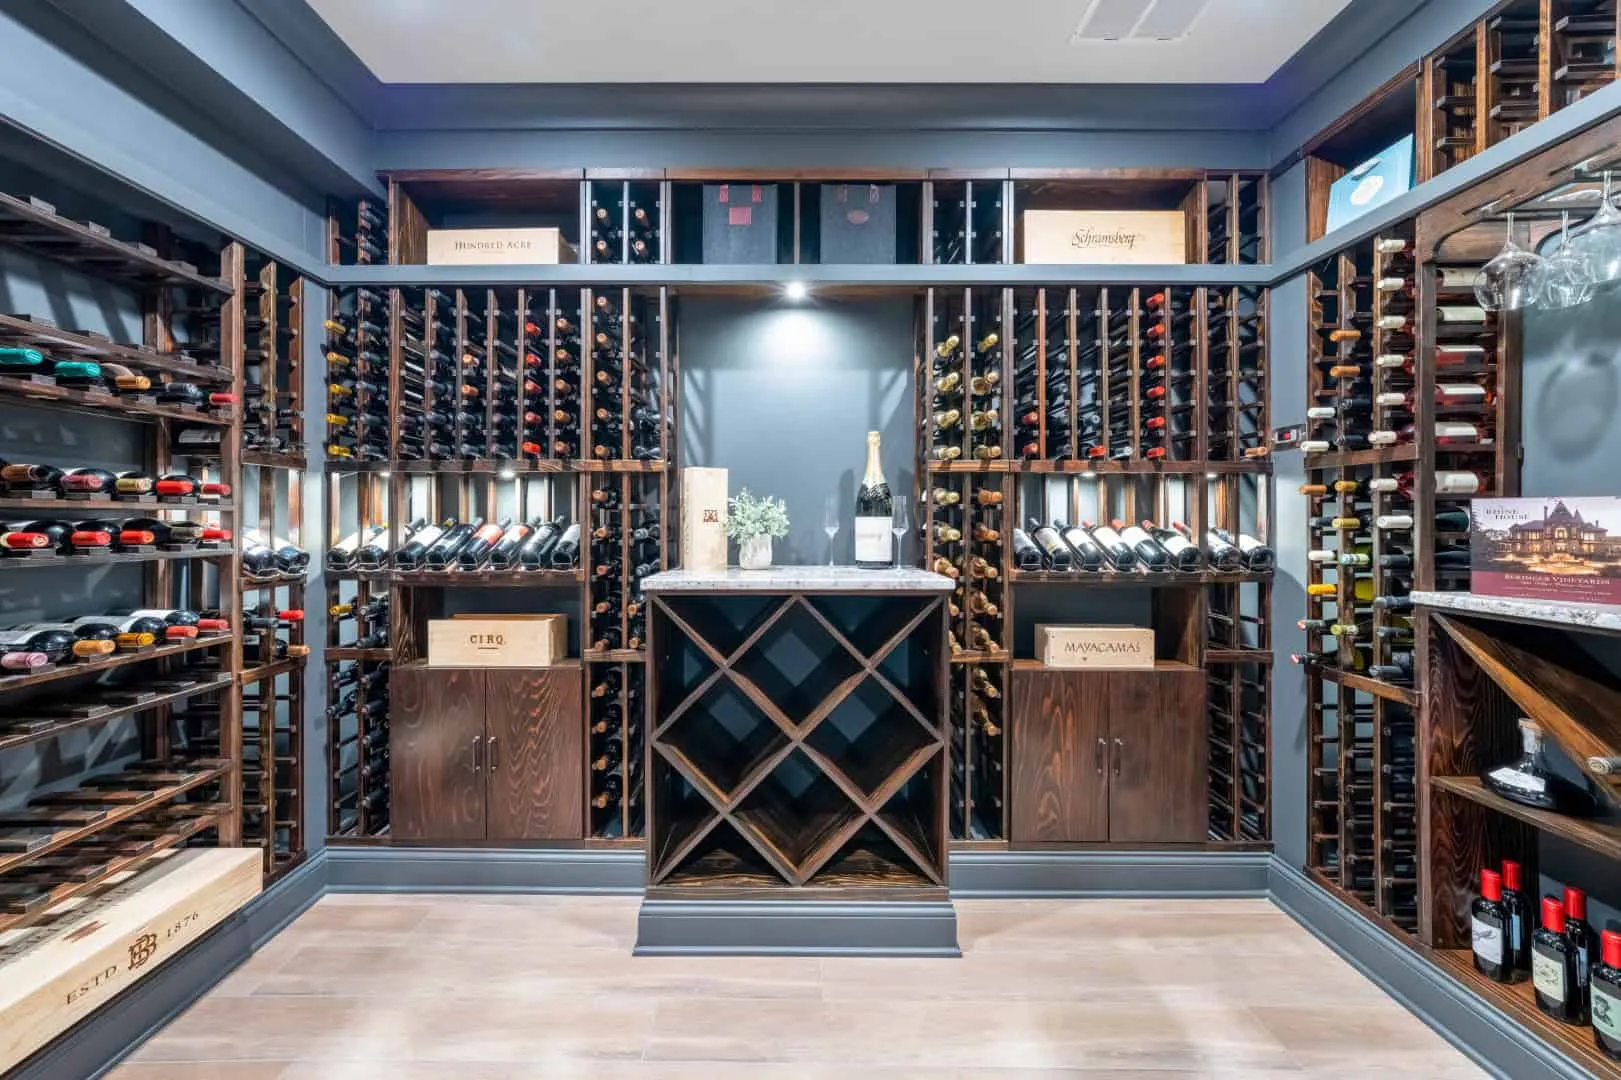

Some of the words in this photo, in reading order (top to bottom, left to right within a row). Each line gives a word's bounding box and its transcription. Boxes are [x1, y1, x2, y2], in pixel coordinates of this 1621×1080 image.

[1064, 642, 1141, 654] MAYACAMAS
[66, 965, 117, 1005] ESTD
[167, 911, 199, 938] 1876
